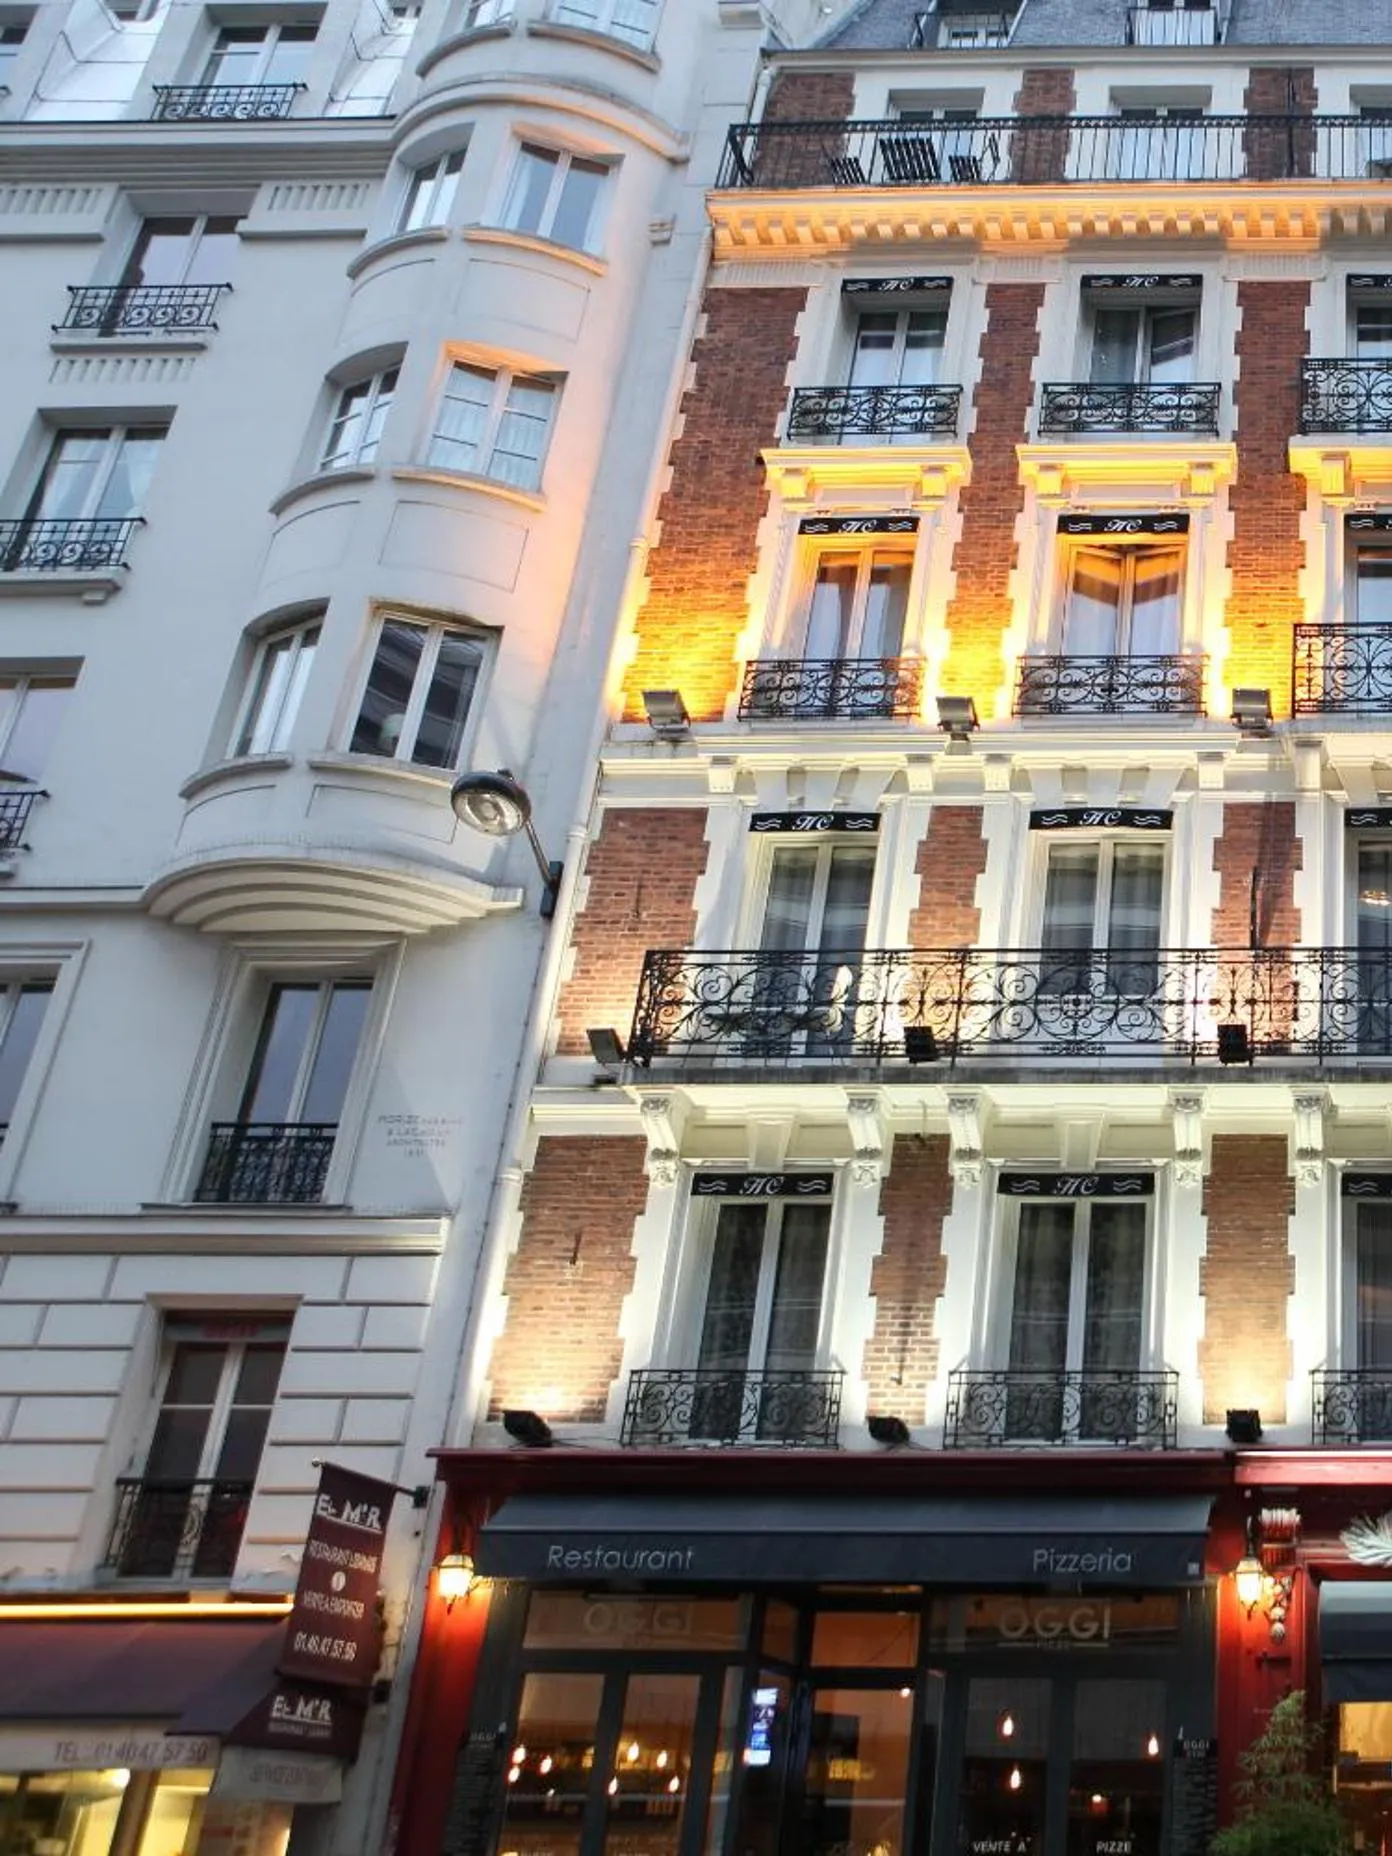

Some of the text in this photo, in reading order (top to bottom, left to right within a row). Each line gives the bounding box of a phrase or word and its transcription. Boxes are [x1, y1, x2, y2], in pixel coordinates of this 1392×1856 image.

[547, 1544, 696, 1571] Restaurant
[1033, 1547, 1133, 1573] Pizzeria
[1000, 1602, 1112, 1640] OGGI
